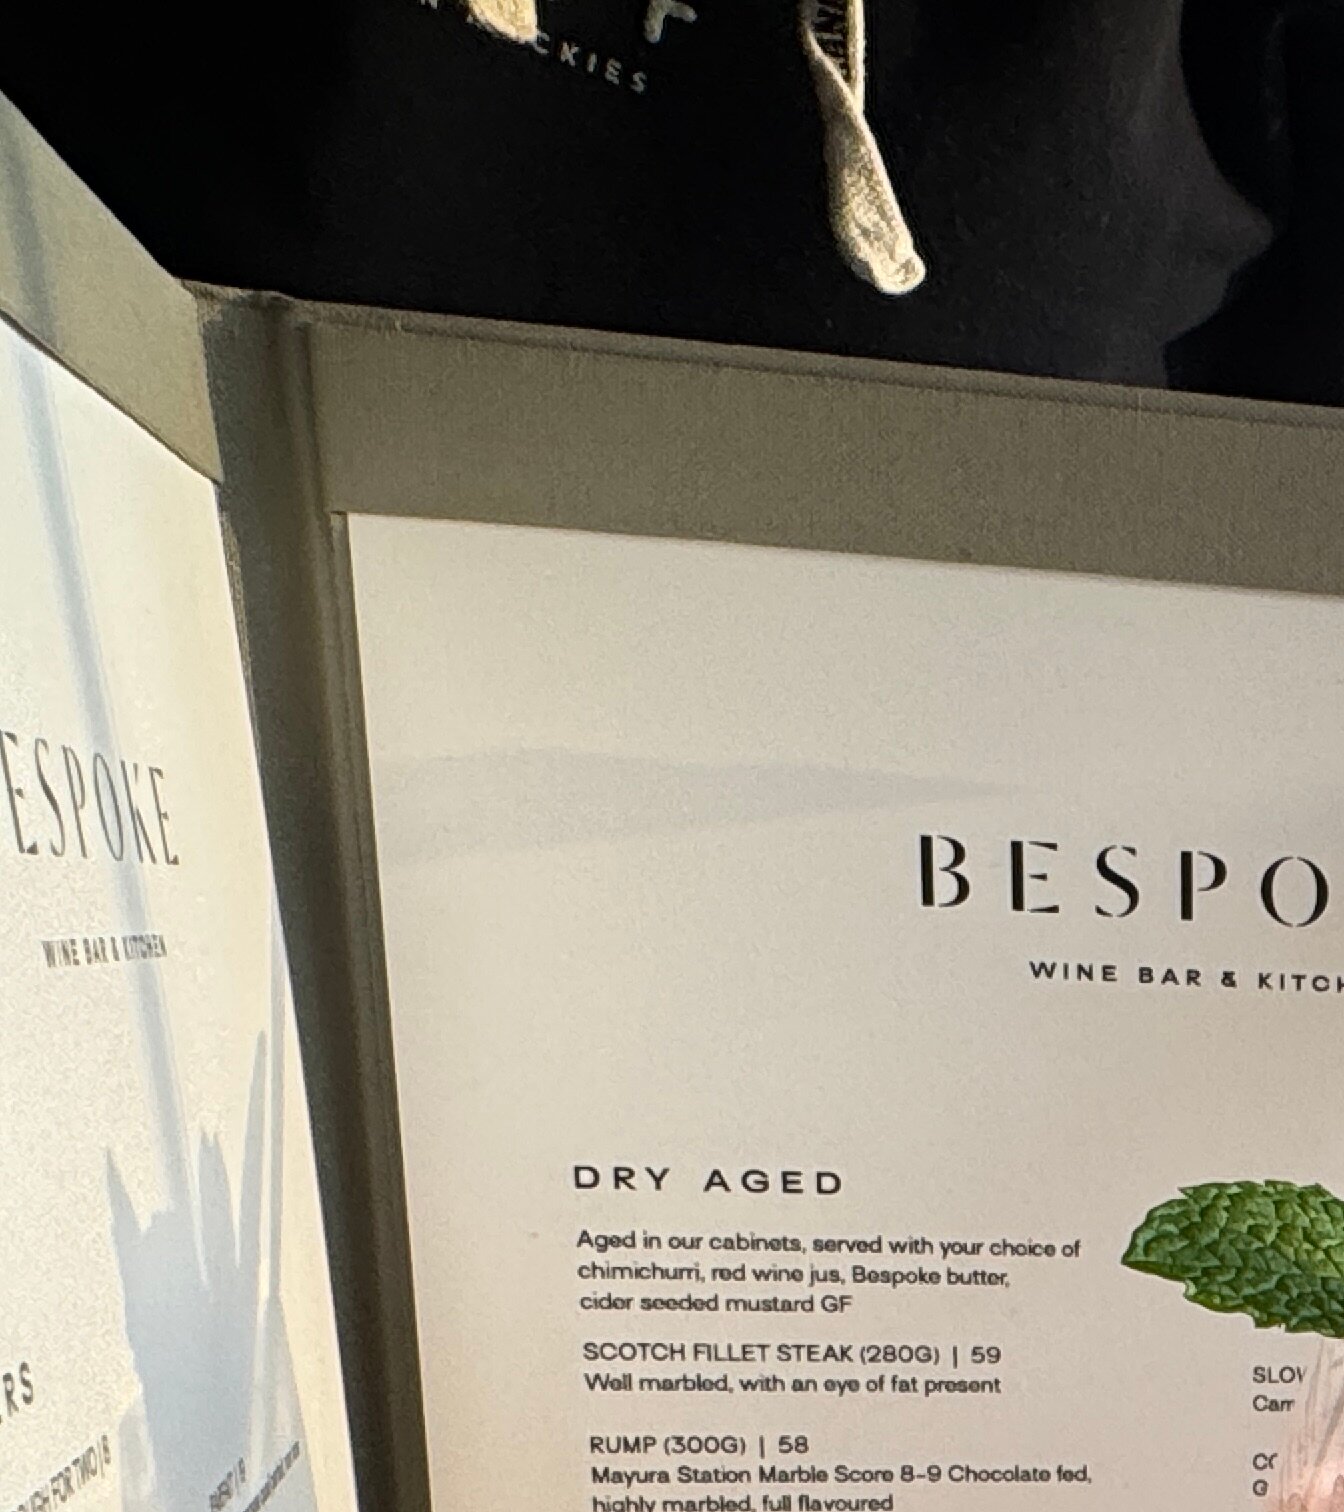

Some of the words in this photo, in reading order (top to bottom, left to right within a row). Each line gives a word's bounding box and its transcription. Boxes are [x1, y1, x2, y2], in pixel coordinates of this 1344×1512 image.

[1028, 960, 1118, 983] WINE
[1138, 966, 1202, 987] BAR
[1220, 970, 1238, 989] &
[573, 1164, 670, 1191] DRY
[703, 1168, 842, 1196] AGED
[576, 1229, 637, 1254] Aged
[642, 1229, 662, 1250] in
[667, 1235, 704, 1250] our
[708, 1231, 808, 1255] cabinets,
[812, 1234, 883, 1254] served
[887, 1235, 934, 1256] with
[938, 1240, 985, 1261] your
[988, 1238, 1057, 1258] choice
[1060, 1238, 1081, 1258] of
[576, 1260, 706, 1284] chimichurri,
[710, 1262, 747, 1282] red
[750, 1263, 804, 1284] wine
[807, 1263, 846, 1288] jus,
[851, 1264, 942, 1290] Bespoke
[946, 1266, 1010, 1288] butter,
[578, 1291, 635, 1311] cider
[639, 1292, 720, 1312] seeded
[725, 1294, 815, 1314] mustard
[820, 1294, 853, 1314] GF
[582, 1341, 687, 1362] SCOTCH
[692, 1342, 772, 1363] FILLET
[776, 1343, 854, 1363] STEAK
[859, 1344, 940, 1366] (280G)
[970, 1345, 1002, 1365] 59
[583, 1372, 634, 1392] Well
[638, 1372, 734, 1394] marbled,
[738, 1374, 786, 1393] with
[790, 1378, 818, 1393] an
[822, 1378, 861, 1398] eye
[865, 1374, 886, 1393] of
[890, 1374, 919, 1394] fat
[924, 1377, 1002, 1398] present
[589, 1435, 658, 1454] RUMP
[662, 1434, 747, 1456] (300G)
[778, 1434, 810, 1455] 58
[591, 1466, 671, 1490] Mayura
[676, 1464, 752, 1484] Station
[758, 1464, 829, 1484] Marble
[834, 1464, 895, 1484] Score
[947, 1464, 1052, 1484] Chocolate
[1056, 1464, 1092, 1484] fed,
[762, 1494, 792, 1512] full
[797, 1493, 894, 1512] flavoured
